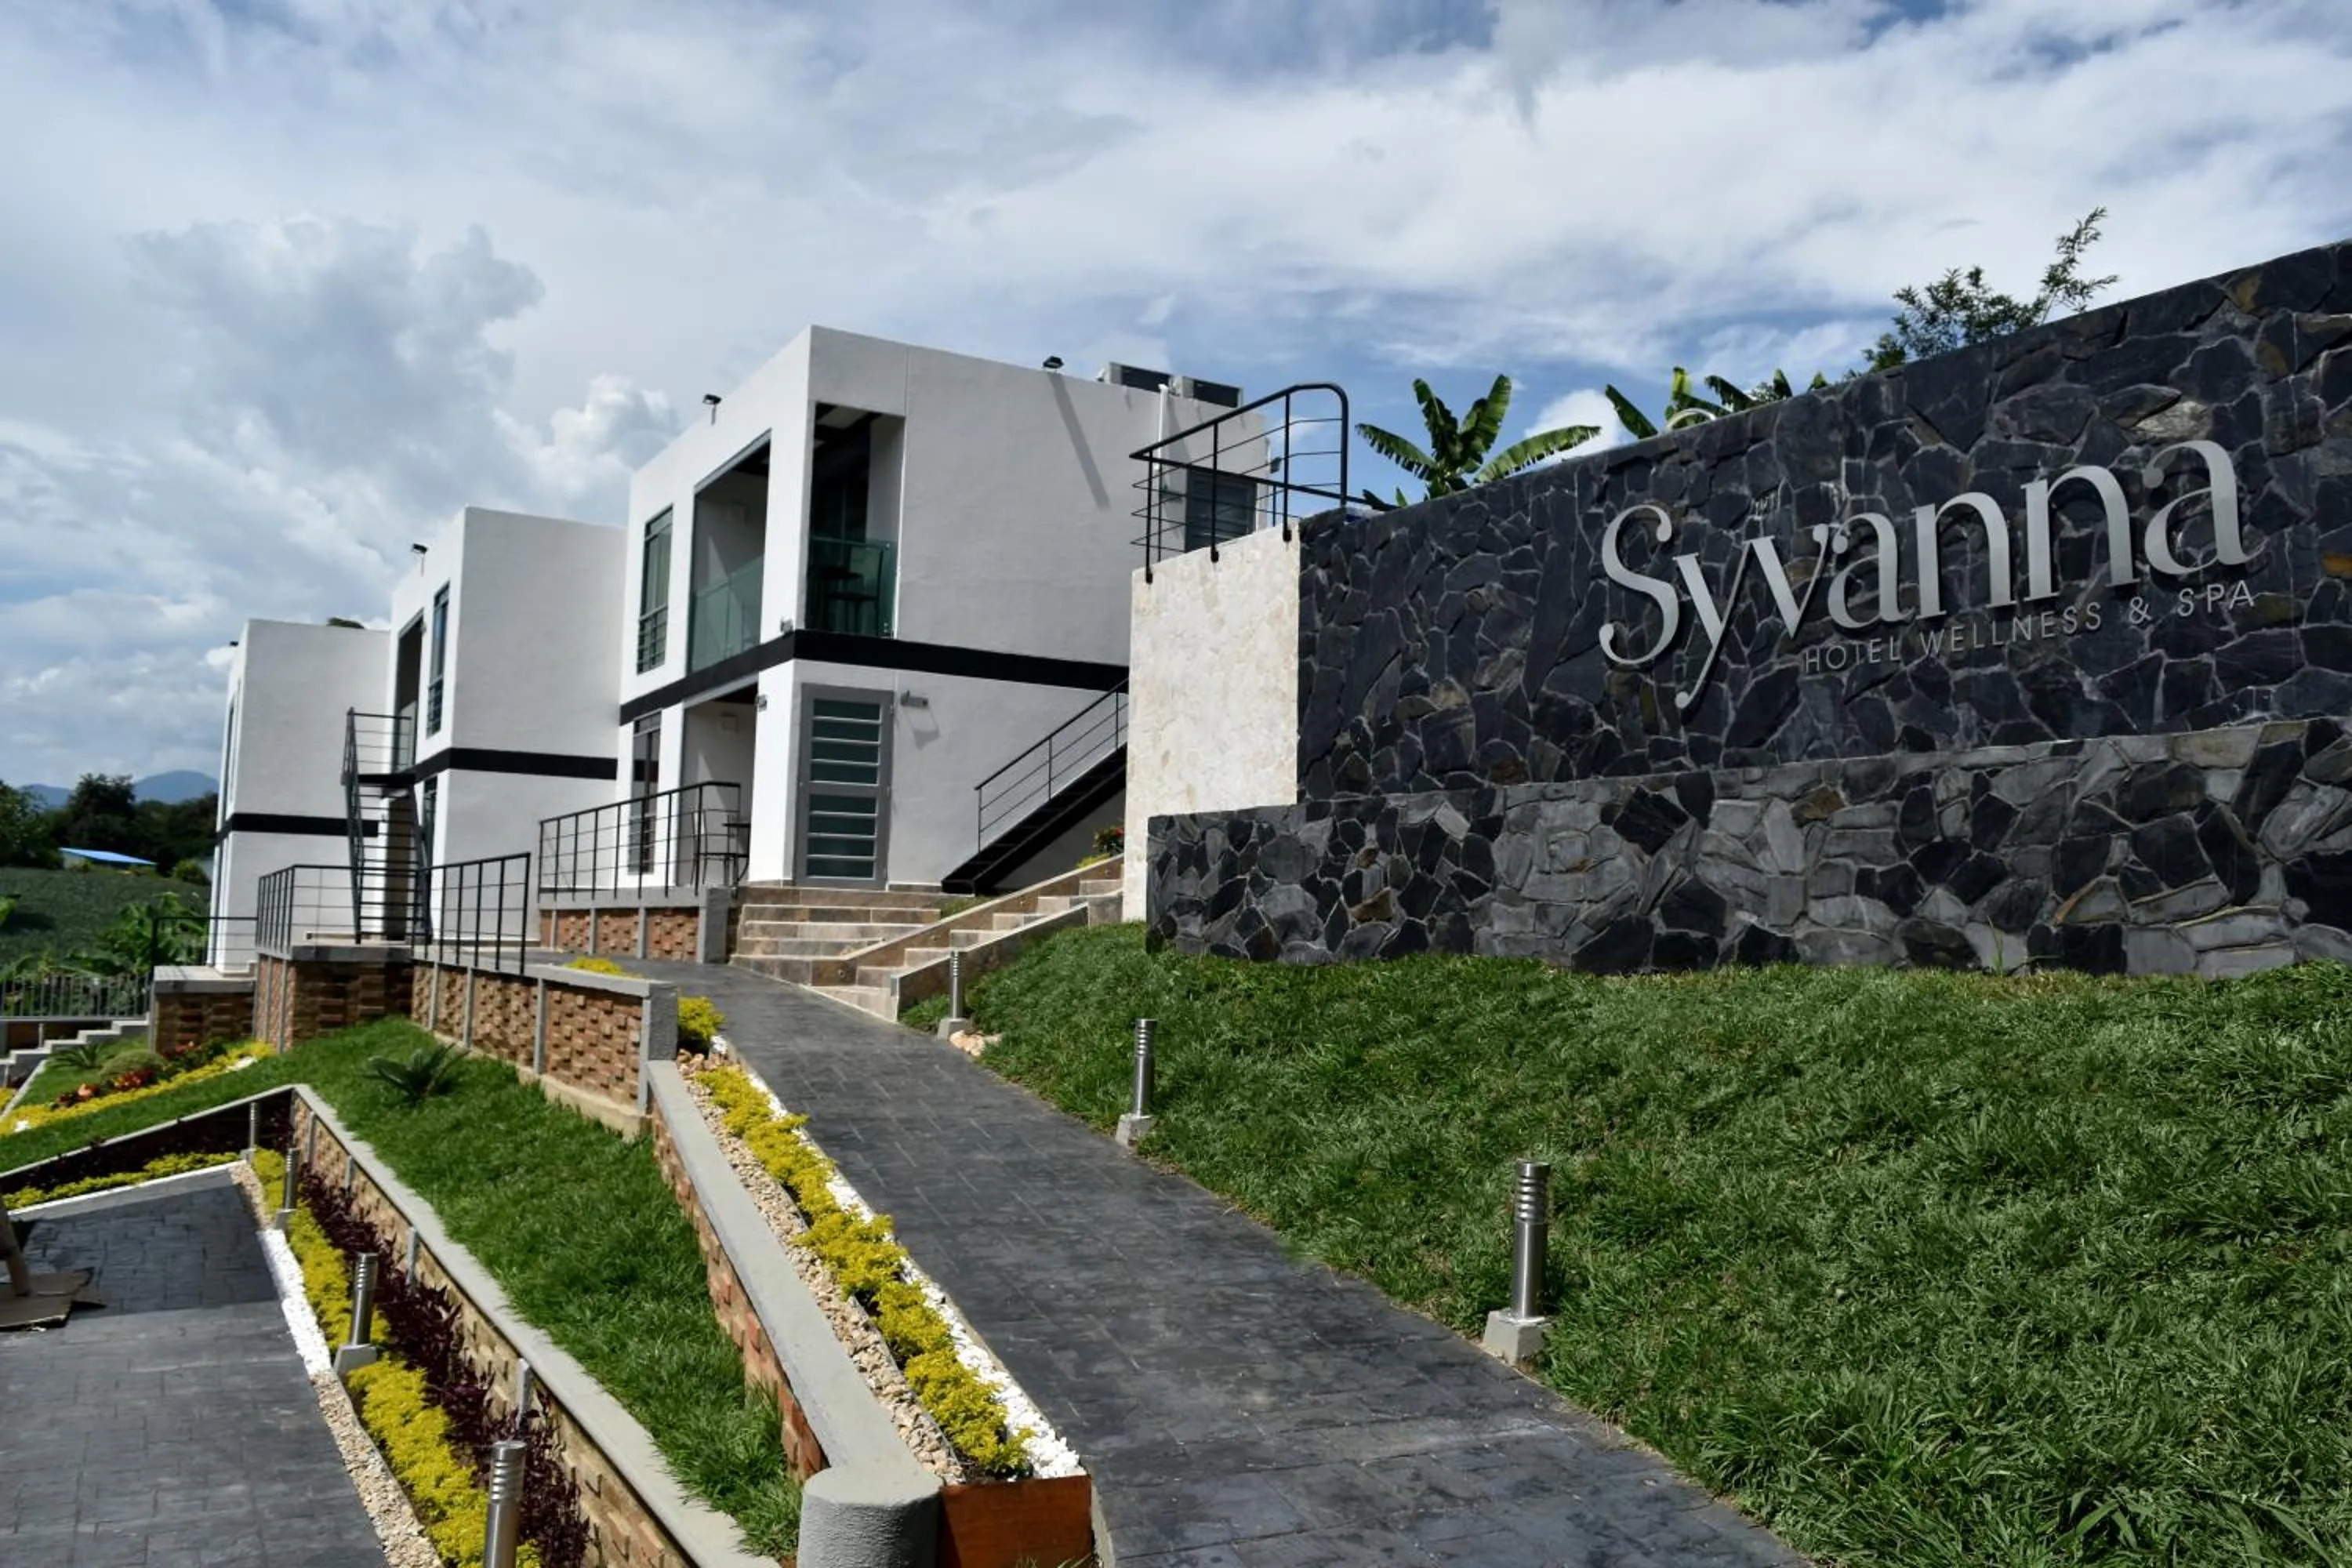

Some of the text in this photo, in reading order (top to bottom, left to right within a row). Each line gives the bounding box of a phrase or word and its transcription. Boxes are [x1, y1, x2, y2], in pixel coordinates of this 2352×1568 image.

[1599, 440, 2268, 709] Syvanna
[1805, 579, 2255, 673] HOTEL WELLNESS & SPA
